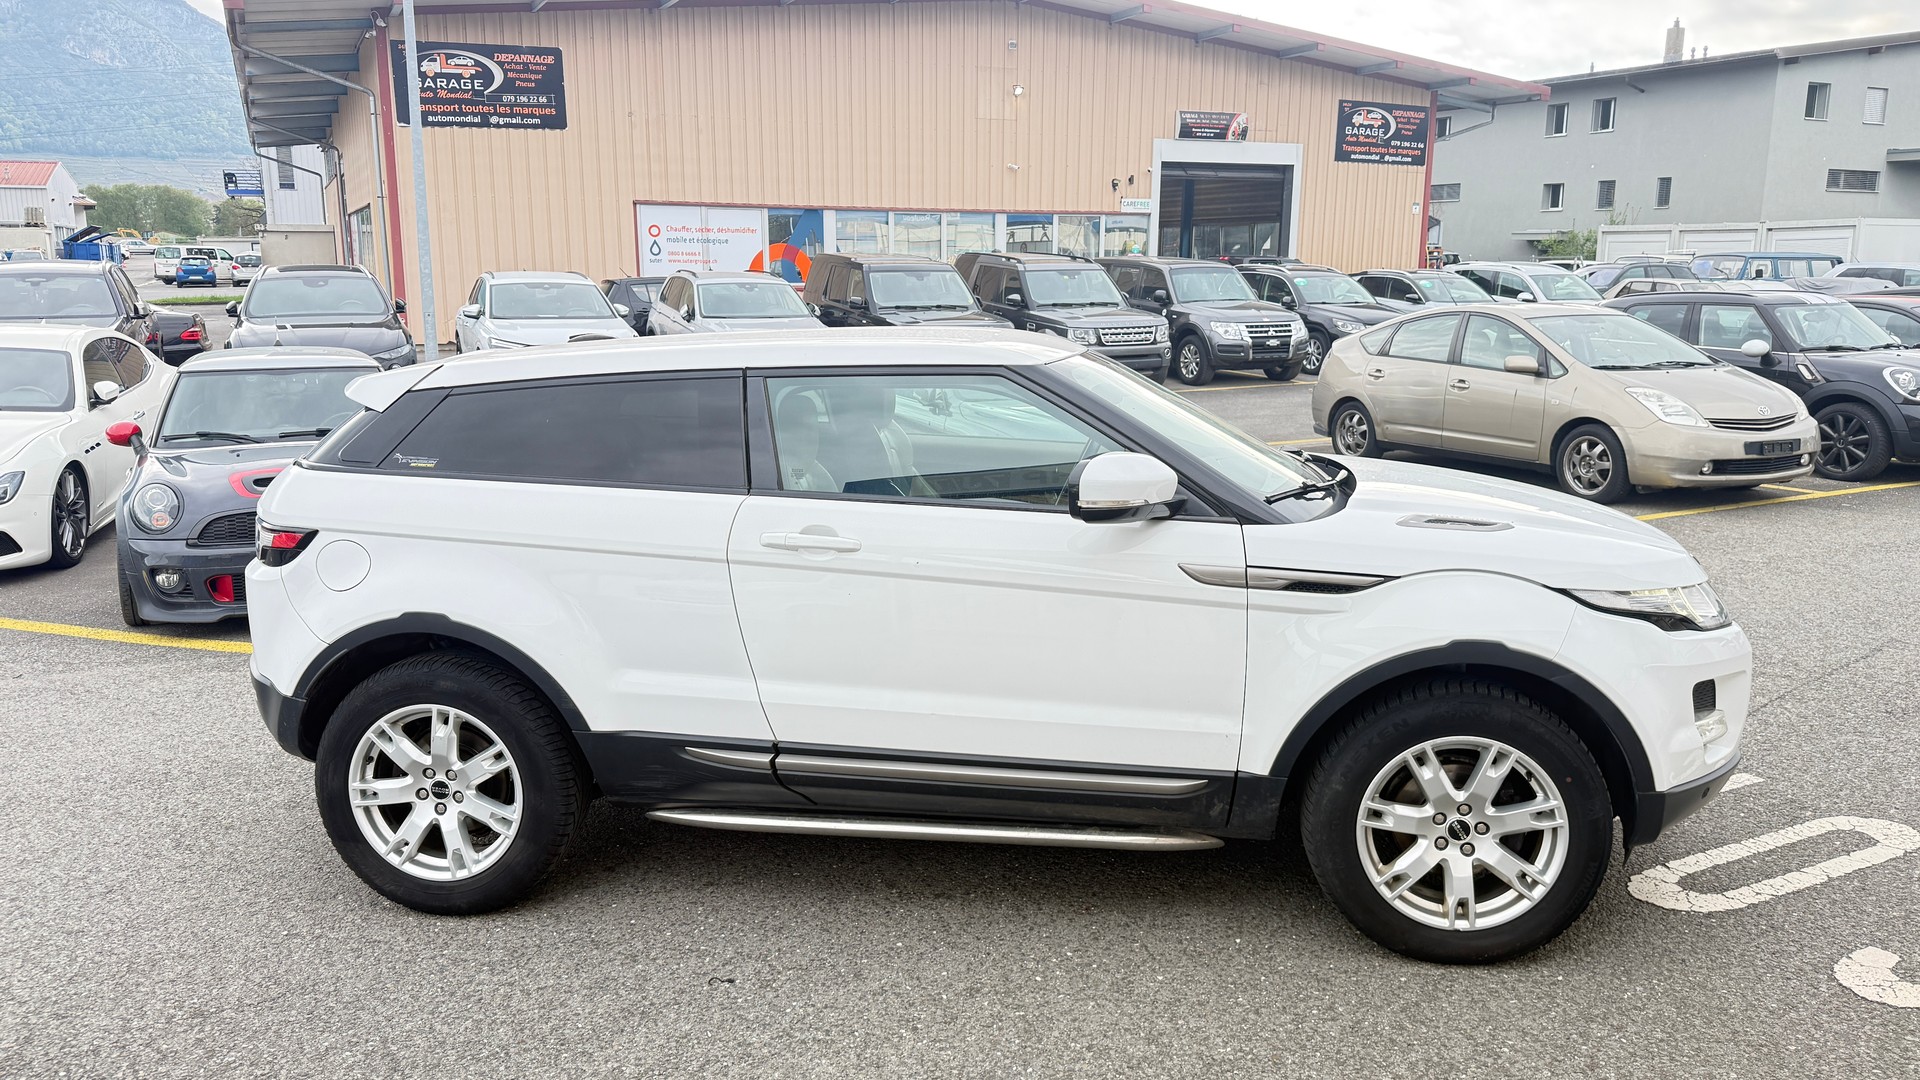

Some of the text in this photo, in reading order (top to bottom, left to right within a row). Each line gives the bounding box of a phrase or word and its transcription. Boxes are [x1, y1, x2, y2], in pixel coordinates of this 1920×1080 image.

[494, 54, 554, 64] DEPANNAGE
[507, 72, 542, 80] Mécanique
[437, 89, 472, 98] Mondial
[420, 104, 459, 113] ansport
[497, 104, 510, 113] les
[514, 106, 556, 116] marques
[1392, 110, 1425, 118] DEPANNAGE
[490, 116, 540, 124] @gmail.com
[1345, 127, 1384, 136] GARAGE
[696, 237, 728, 245] écologique
